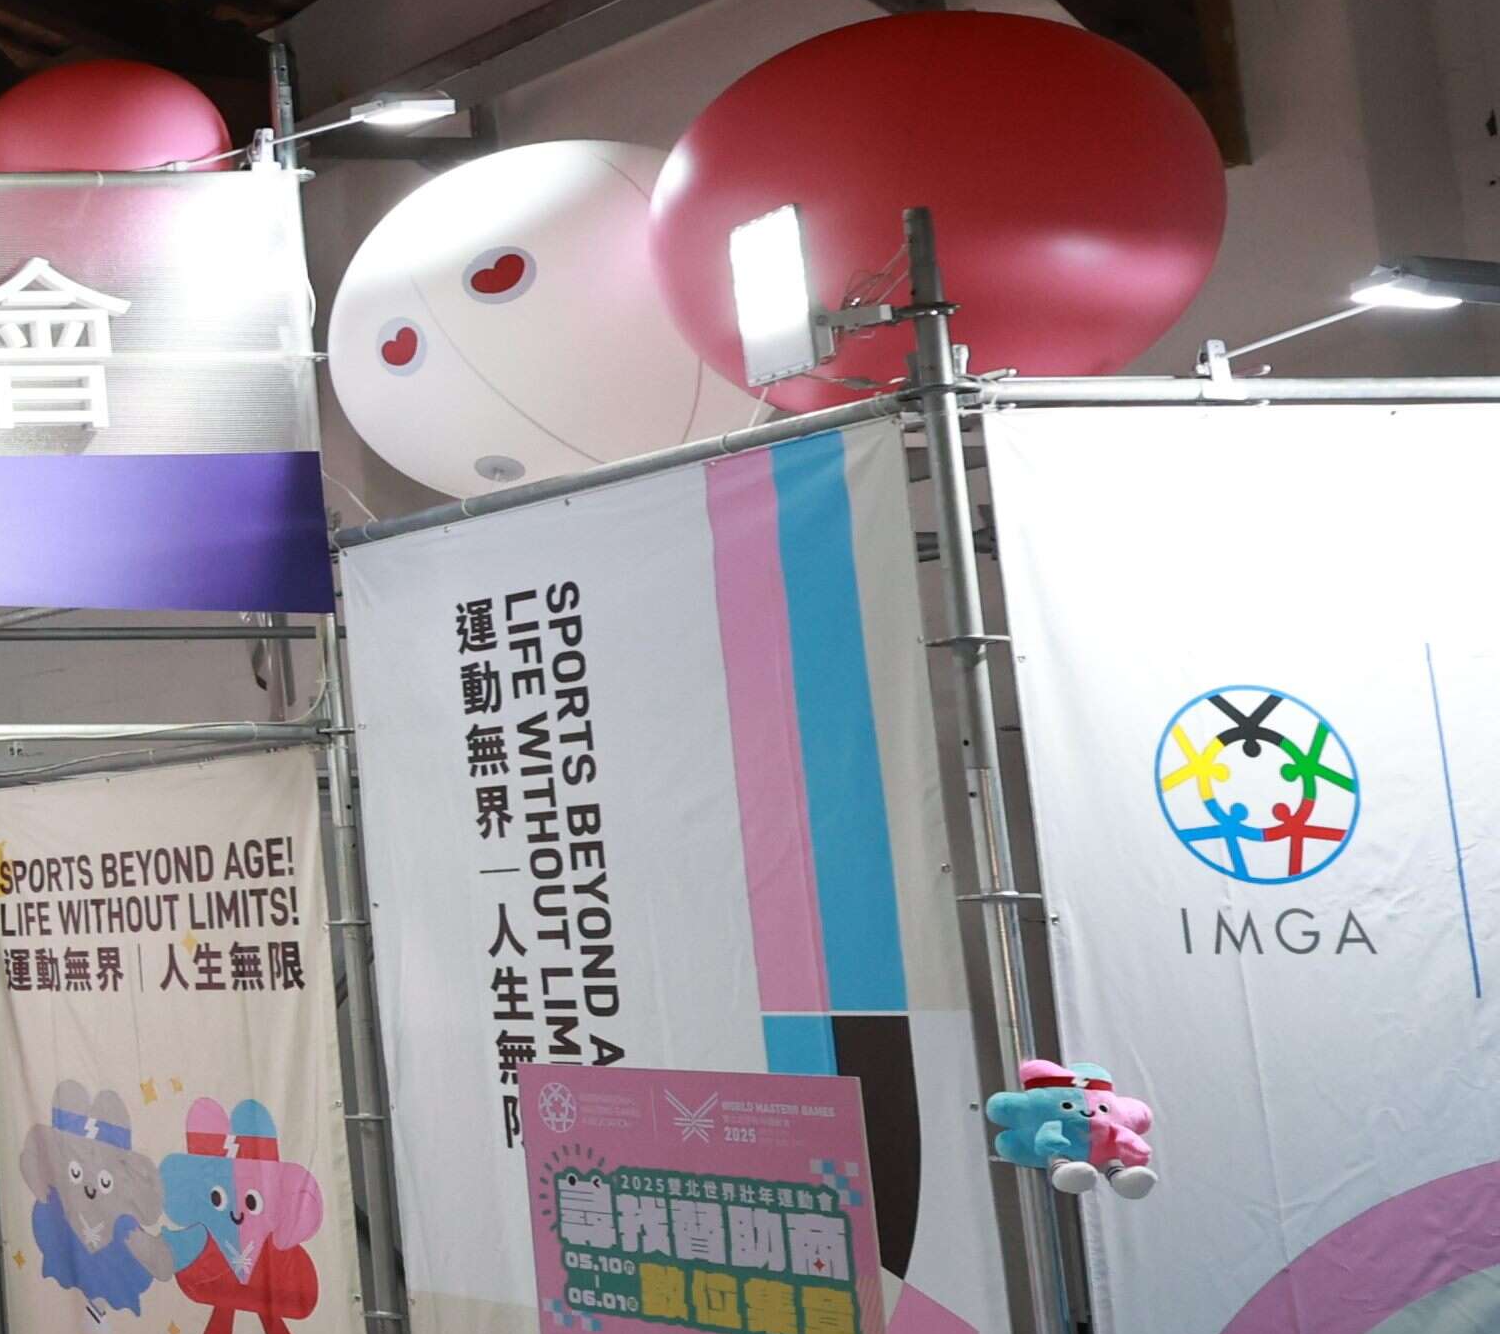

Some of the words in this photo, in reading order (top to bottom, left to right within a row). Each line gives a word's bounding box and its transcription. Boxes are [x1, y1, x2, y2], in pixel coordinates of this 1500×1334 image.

[505, 590, 546, 698] LIFE
[546, 581, 597, 785] SPORTS
[100, 844, 215, 890] BEYOND
[223, 836, 297, 880] AGE!
[517, 712, 571, 950] WITHOUT
[0, 899, 52, 938] LIFE
[57, 892, 180, 935] WITHOUT
[187, 886, 301, 930] LIMITS!
[567, 803, 620, 1018] BEYOND
[1180, 907, 1378, 955] IMGA
[724, 1126, 757, 1143] 2025
